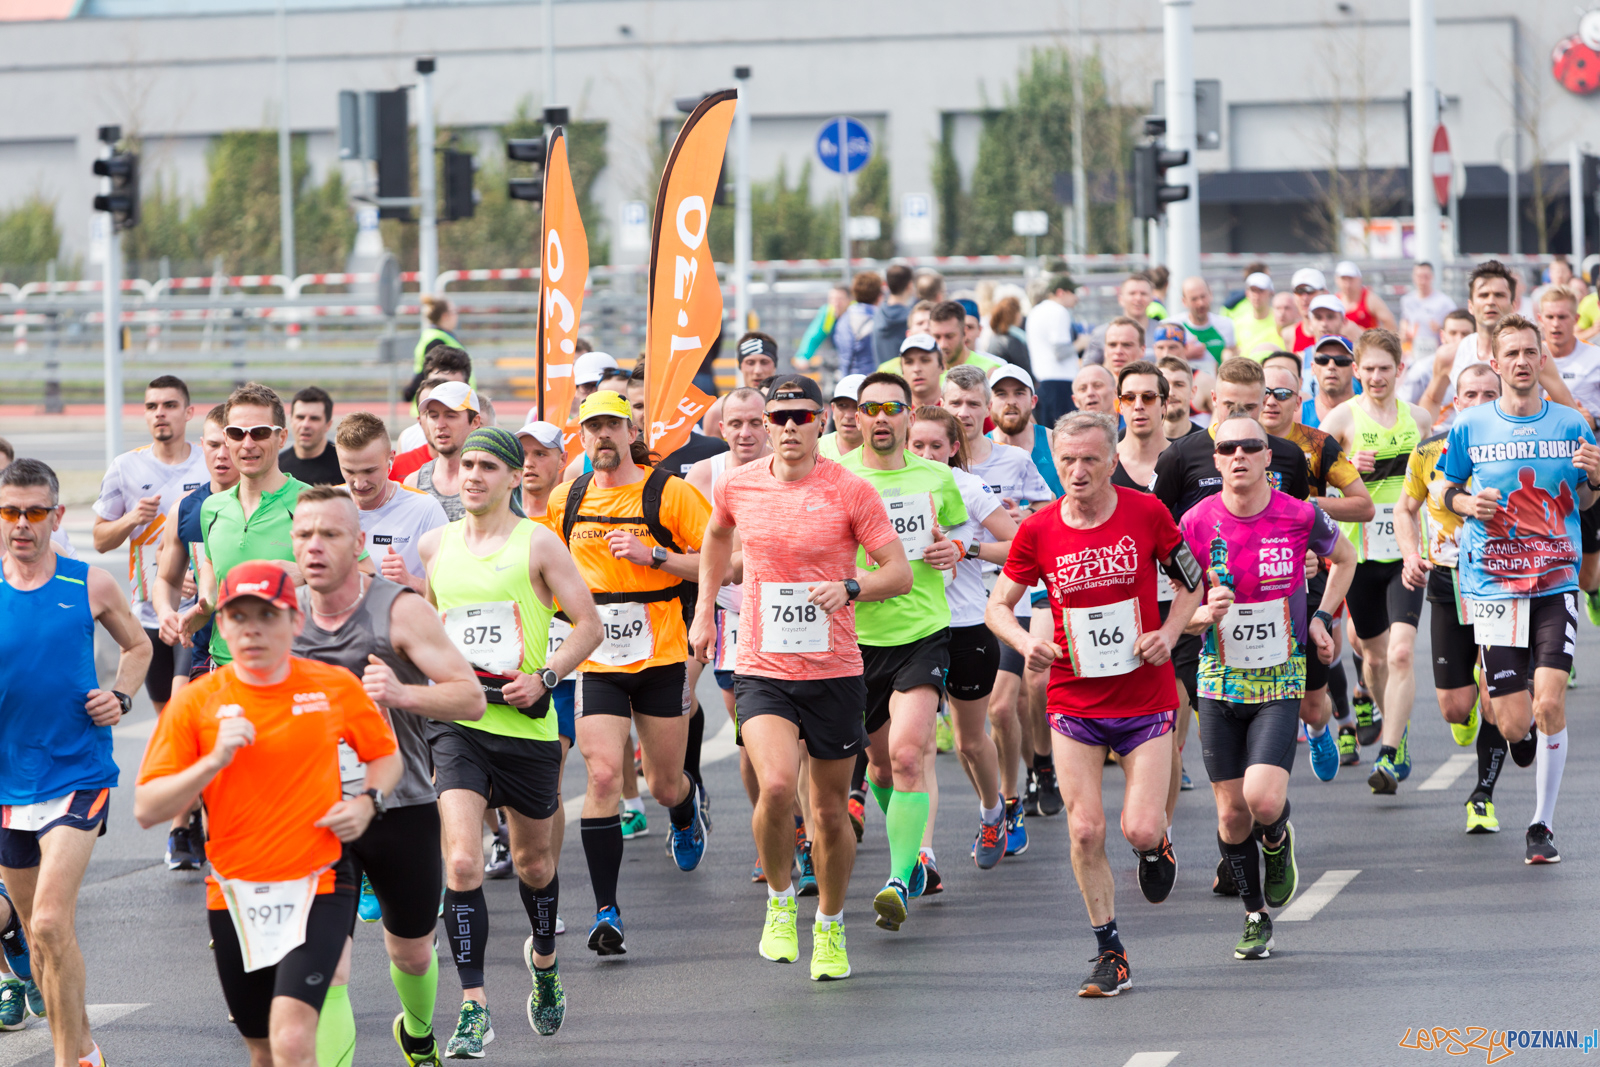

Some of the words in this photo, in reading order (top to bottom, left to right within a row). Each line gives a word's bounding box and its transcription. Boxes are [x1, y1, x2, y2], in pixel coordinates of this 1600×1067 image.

[1538, 440, 1579, 458] BUBLI
[889, 515, 925, 534] 861
[1055, 544, 1125, 568] DRUŻYNA
[1259, 547, 1294, 561] FSD
[1057, 553, 1138, 586] SZPIKU
[1259, 562, 1294, 577] RUN
[1488, 557, 1532, 572] GRUPA
[1062, 576, 1135, 595] www.darszpiku.pl
[771, 605, 817, 623] 7618
[463, 626, 502, 645] 875
[603, 620, 643, 640] 1549
[1088, 626, 1125, 647] 166
[1232, 622, 1276, 641] 6751
[1481, 747, 1504, 788] Kalenji
[1225, 853, 1251, 897] Kalenji
[247, 904, 295, 928] 9917
[533, 895, 555, 936] Kalenji
[452, 904, 475, 963] Kalenji
